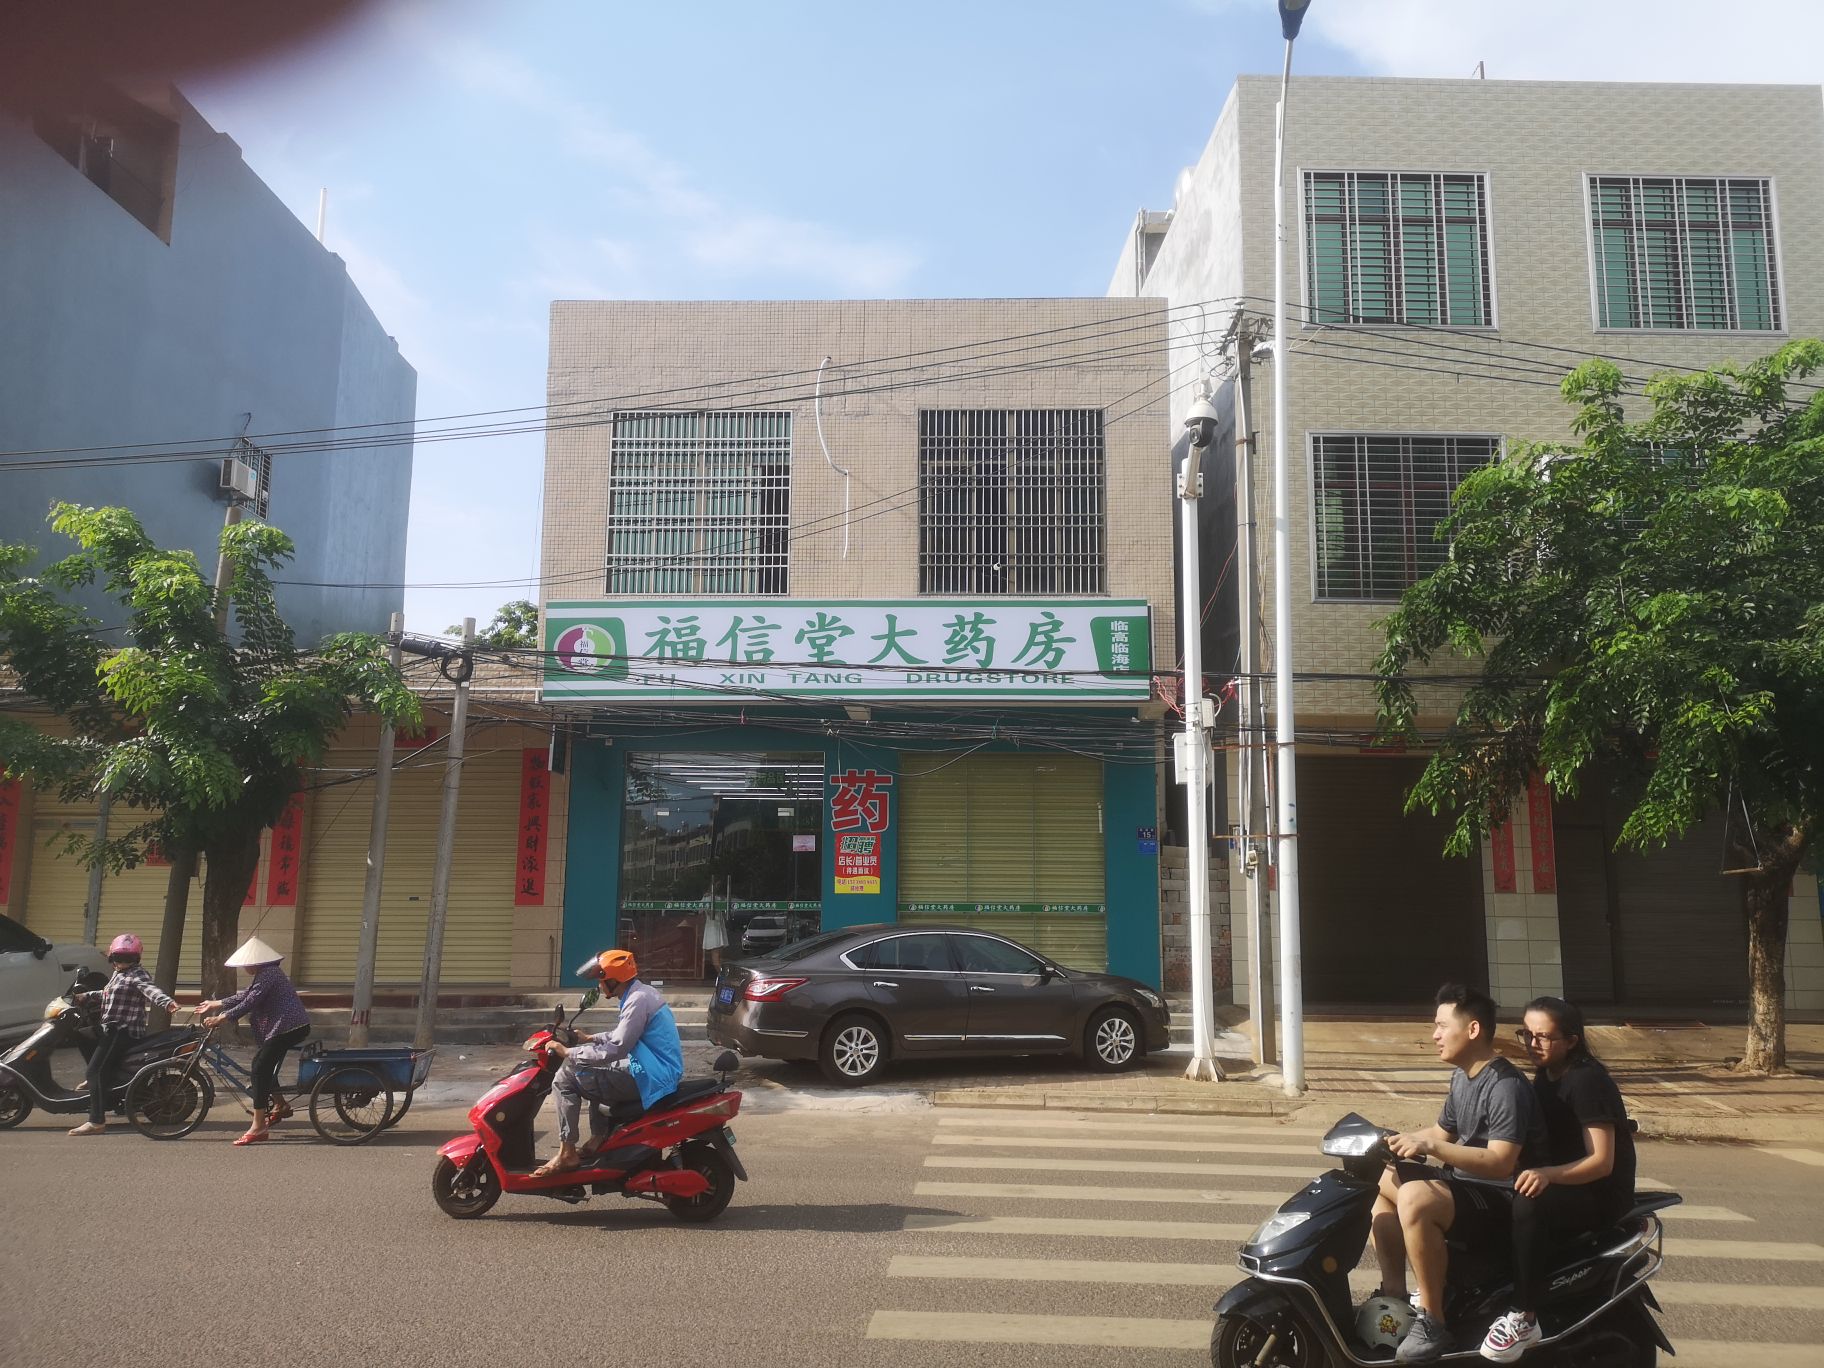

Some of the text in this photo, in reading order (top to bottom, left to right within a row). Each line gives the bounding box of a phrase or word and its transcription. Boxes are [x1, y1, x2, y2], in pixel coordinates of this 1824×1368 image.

[642, 611, 1077, 669] 福信堂大药房
[720, 673, 765, 685] XIN
[789, 673, 863, 685] TANG
[906, 673, 1075, 684] DRUGSTORE
[830, 769, 893, 833] 药
